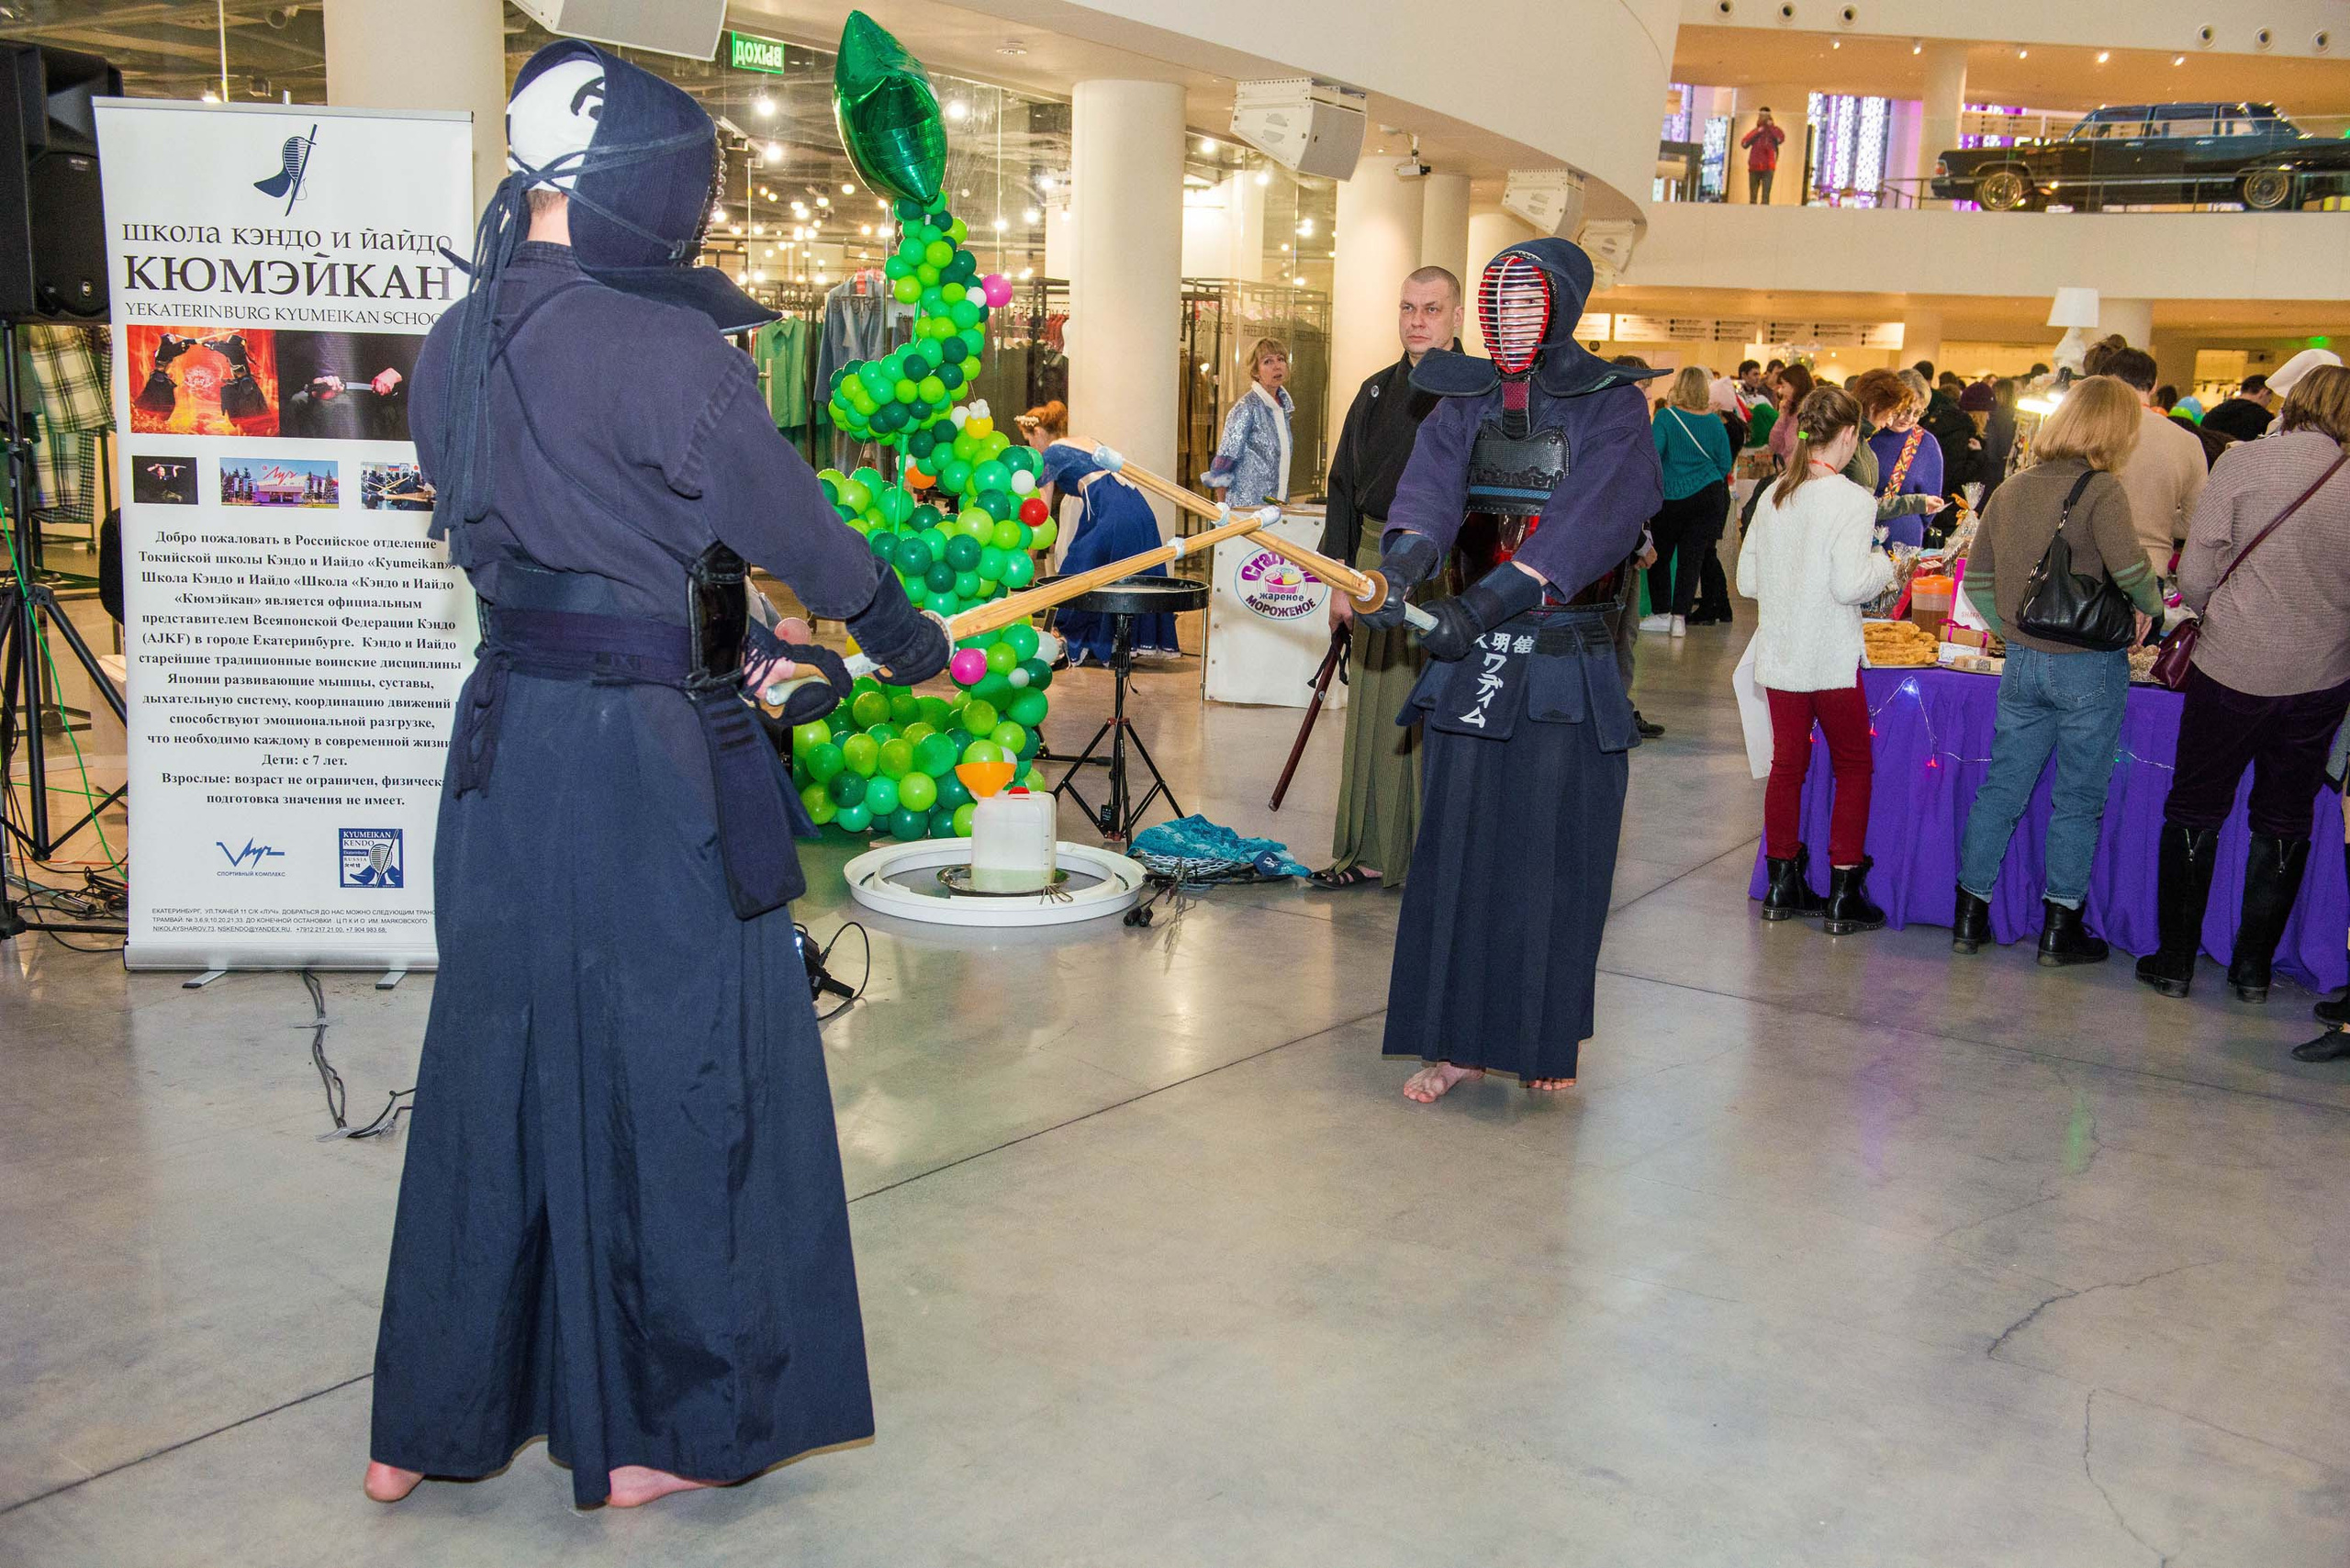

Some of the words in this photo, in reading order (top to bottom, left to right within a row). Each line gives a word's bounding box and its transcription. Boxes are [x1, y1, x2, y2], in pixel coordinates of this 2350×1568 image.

[122, 223, 222, 244] школа
[231, 226, 321, 252] кэндо
[331, 230, 352, 250] и
[360, 227, 453, 255] йайдо
[123, 252, 454, 301] КЮМЭЙКАН
[125, 302, 270, 320] YEKATERINBURG
[274, 308, 380, 325] KYUMEIKAN
[155, 531, 196, 544] Добро
[201, 535, 279, 543] пожаловать
[295, 534, 369, 546] Российское
[373, 537, 438, 549] отделение
[138, 551, 210, 563] Токийской
[216, 555, 262, 564] школы
[267, 554, 306, 566] Кэндо
[322, 555, 364, 567] Иайдо
[367, 556, 455, 570] «Kyumeikan».
[141, 572, 187, 583] Школа
[192, 573, 232, 584] Кэндо
[249, 574, 289, 586] Иайдо
[294, 576, 347, 586] «Школа
[352, 577, 397, 588] «Кэндо
[413, 578, 453, 589] Иайдо
[174, 593, 261, 604] «Кюмэйкан»
[264, 598, 323, 606] является
[328, 596, 421, 609] официальным
[1259, 592, 1304, 602] жареное
[1245, 594, 1316, 618] МОРОЖЕНОЕ
[142, 615, 248, 625] представителем
[253, 615, 337, 626] Всеяпонской
[341, 617, 412, 630] Федерации
[417, 618, 455, 630] Кэндо
[142, 633, 190, 645] (AJKF)
[207, 636, 249, 646] городе
[253, 634, 353, 649] Екатеринбурге.
[362, 636, 400, 648] Кэндо
[417, 638, 456, 650] Иайдо
[139, 653, 210, 666] старейшие
[214, 656, 311, 666] традиционные
[316, 658, 376, 666] воинские
[380, 660, 461, 668] дисциплины
[167, 674, 219, 684] Японии
[224, 677, 314, 687] развивающие
[319, 678, 375, 688] мышцы,
[378, 679, 433, 690] суставы,
[142, 695, 232, 706] дыхательную
[237, 697, 290, 708] систему,
[295, 698, 384, 709] координацию
[387, 699, 450, 708] движений
[169, 713, 260, 726] способствуют
[263, 716, 365, 726] эмоциональной
[370, 719, 434, 729] разгрузке,
[174, 734, 249, 745] необходимо
[253, 737, 310, 747] каждому
[325, 736, 408, 748] современной
[261, 754, 297, 766] Дети:
[312, 755, 319, 765] 7
[162, 773, 229, 785] Взрослые:
[235, 776, 284, 787] возраст
[306, 777, 377, 787] ограничен,
[382, 775, 444, 790] физическ
[207, 795, 278, 803] подготовка
[283, 796, 341, 804] значения
[364, 797, 404, 805] имеет.
